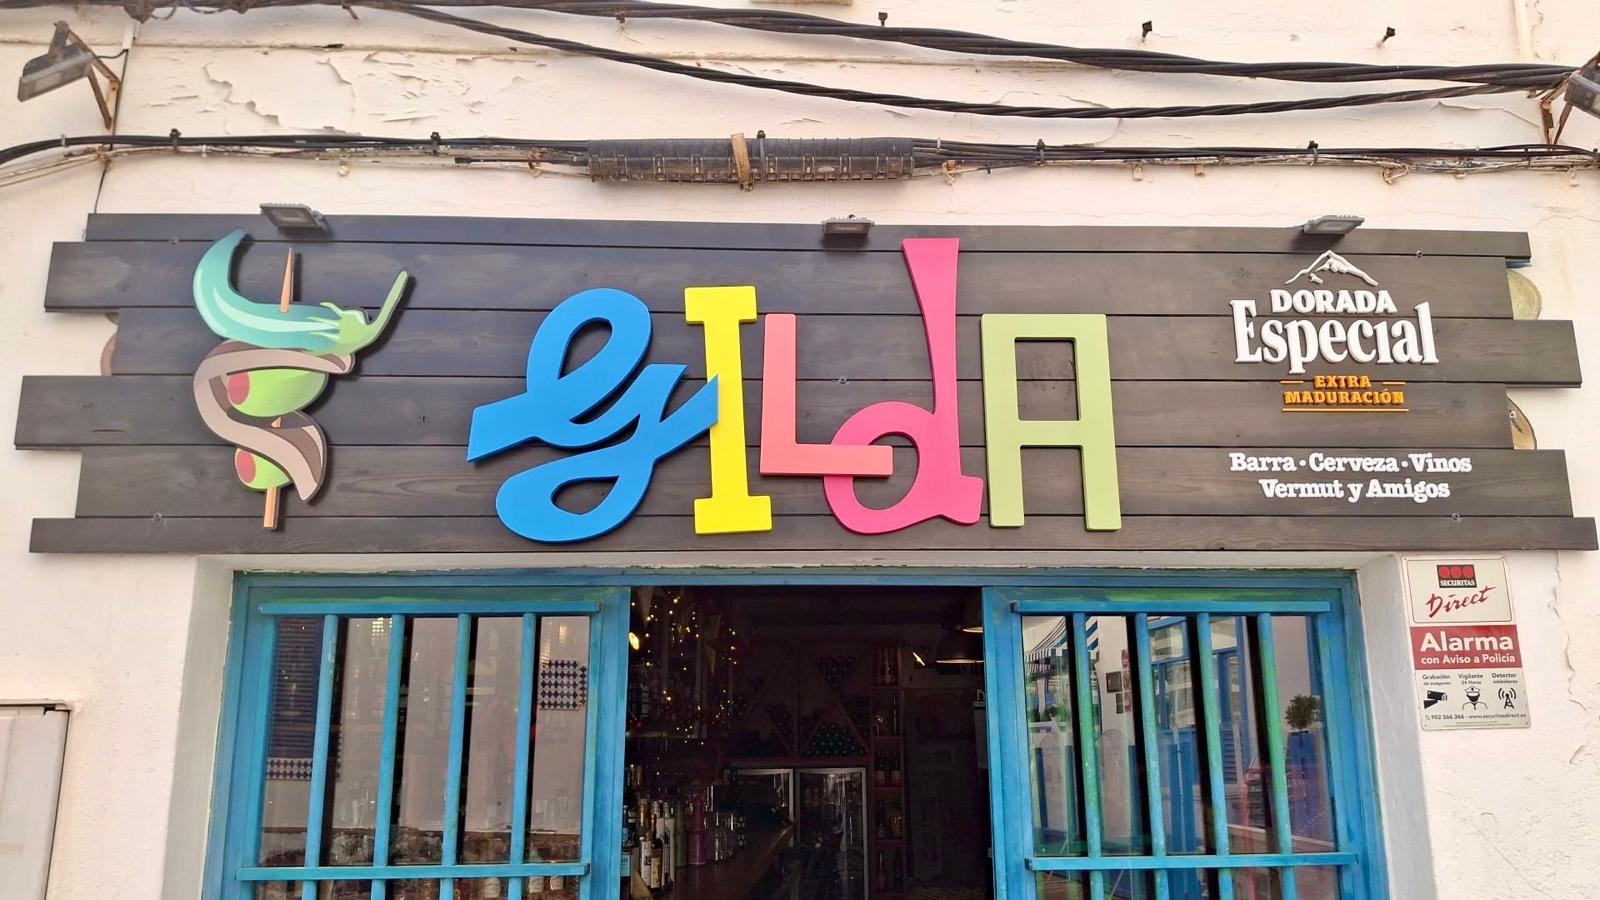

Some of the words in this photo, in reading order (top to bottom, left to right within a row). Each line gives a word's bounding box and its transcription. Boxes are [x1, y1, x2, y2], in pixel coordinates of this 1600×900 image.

[1270, 289, 1398, 314] DORADA
[1229, 299, 1440, 374] Especial
[1313, 375, 1372, 389] EXTRA
[1283, 388, 1405, 405] MADURACIÓN
[1228, 452, 1297, 472] Barra
[1309, 452, 1400, 472] Cerveza
[1408, 453, 1472, 473] Vinos
[1259, 478, 1344, 498] Vermut
[1347, 484, 1363, 503] y
[1366, 478, 1450, 503] Amigos
[1440, 579, 1476, 587] SECURITAS
[1425, 585, 1497, 618] Direct
[1420, 630, 1514, 653] Alarma
[1421, 656, 1440, 665] con
[1442, 654, 1471, 664] Aviso
[1482, 653, 1516, 664] Policía
